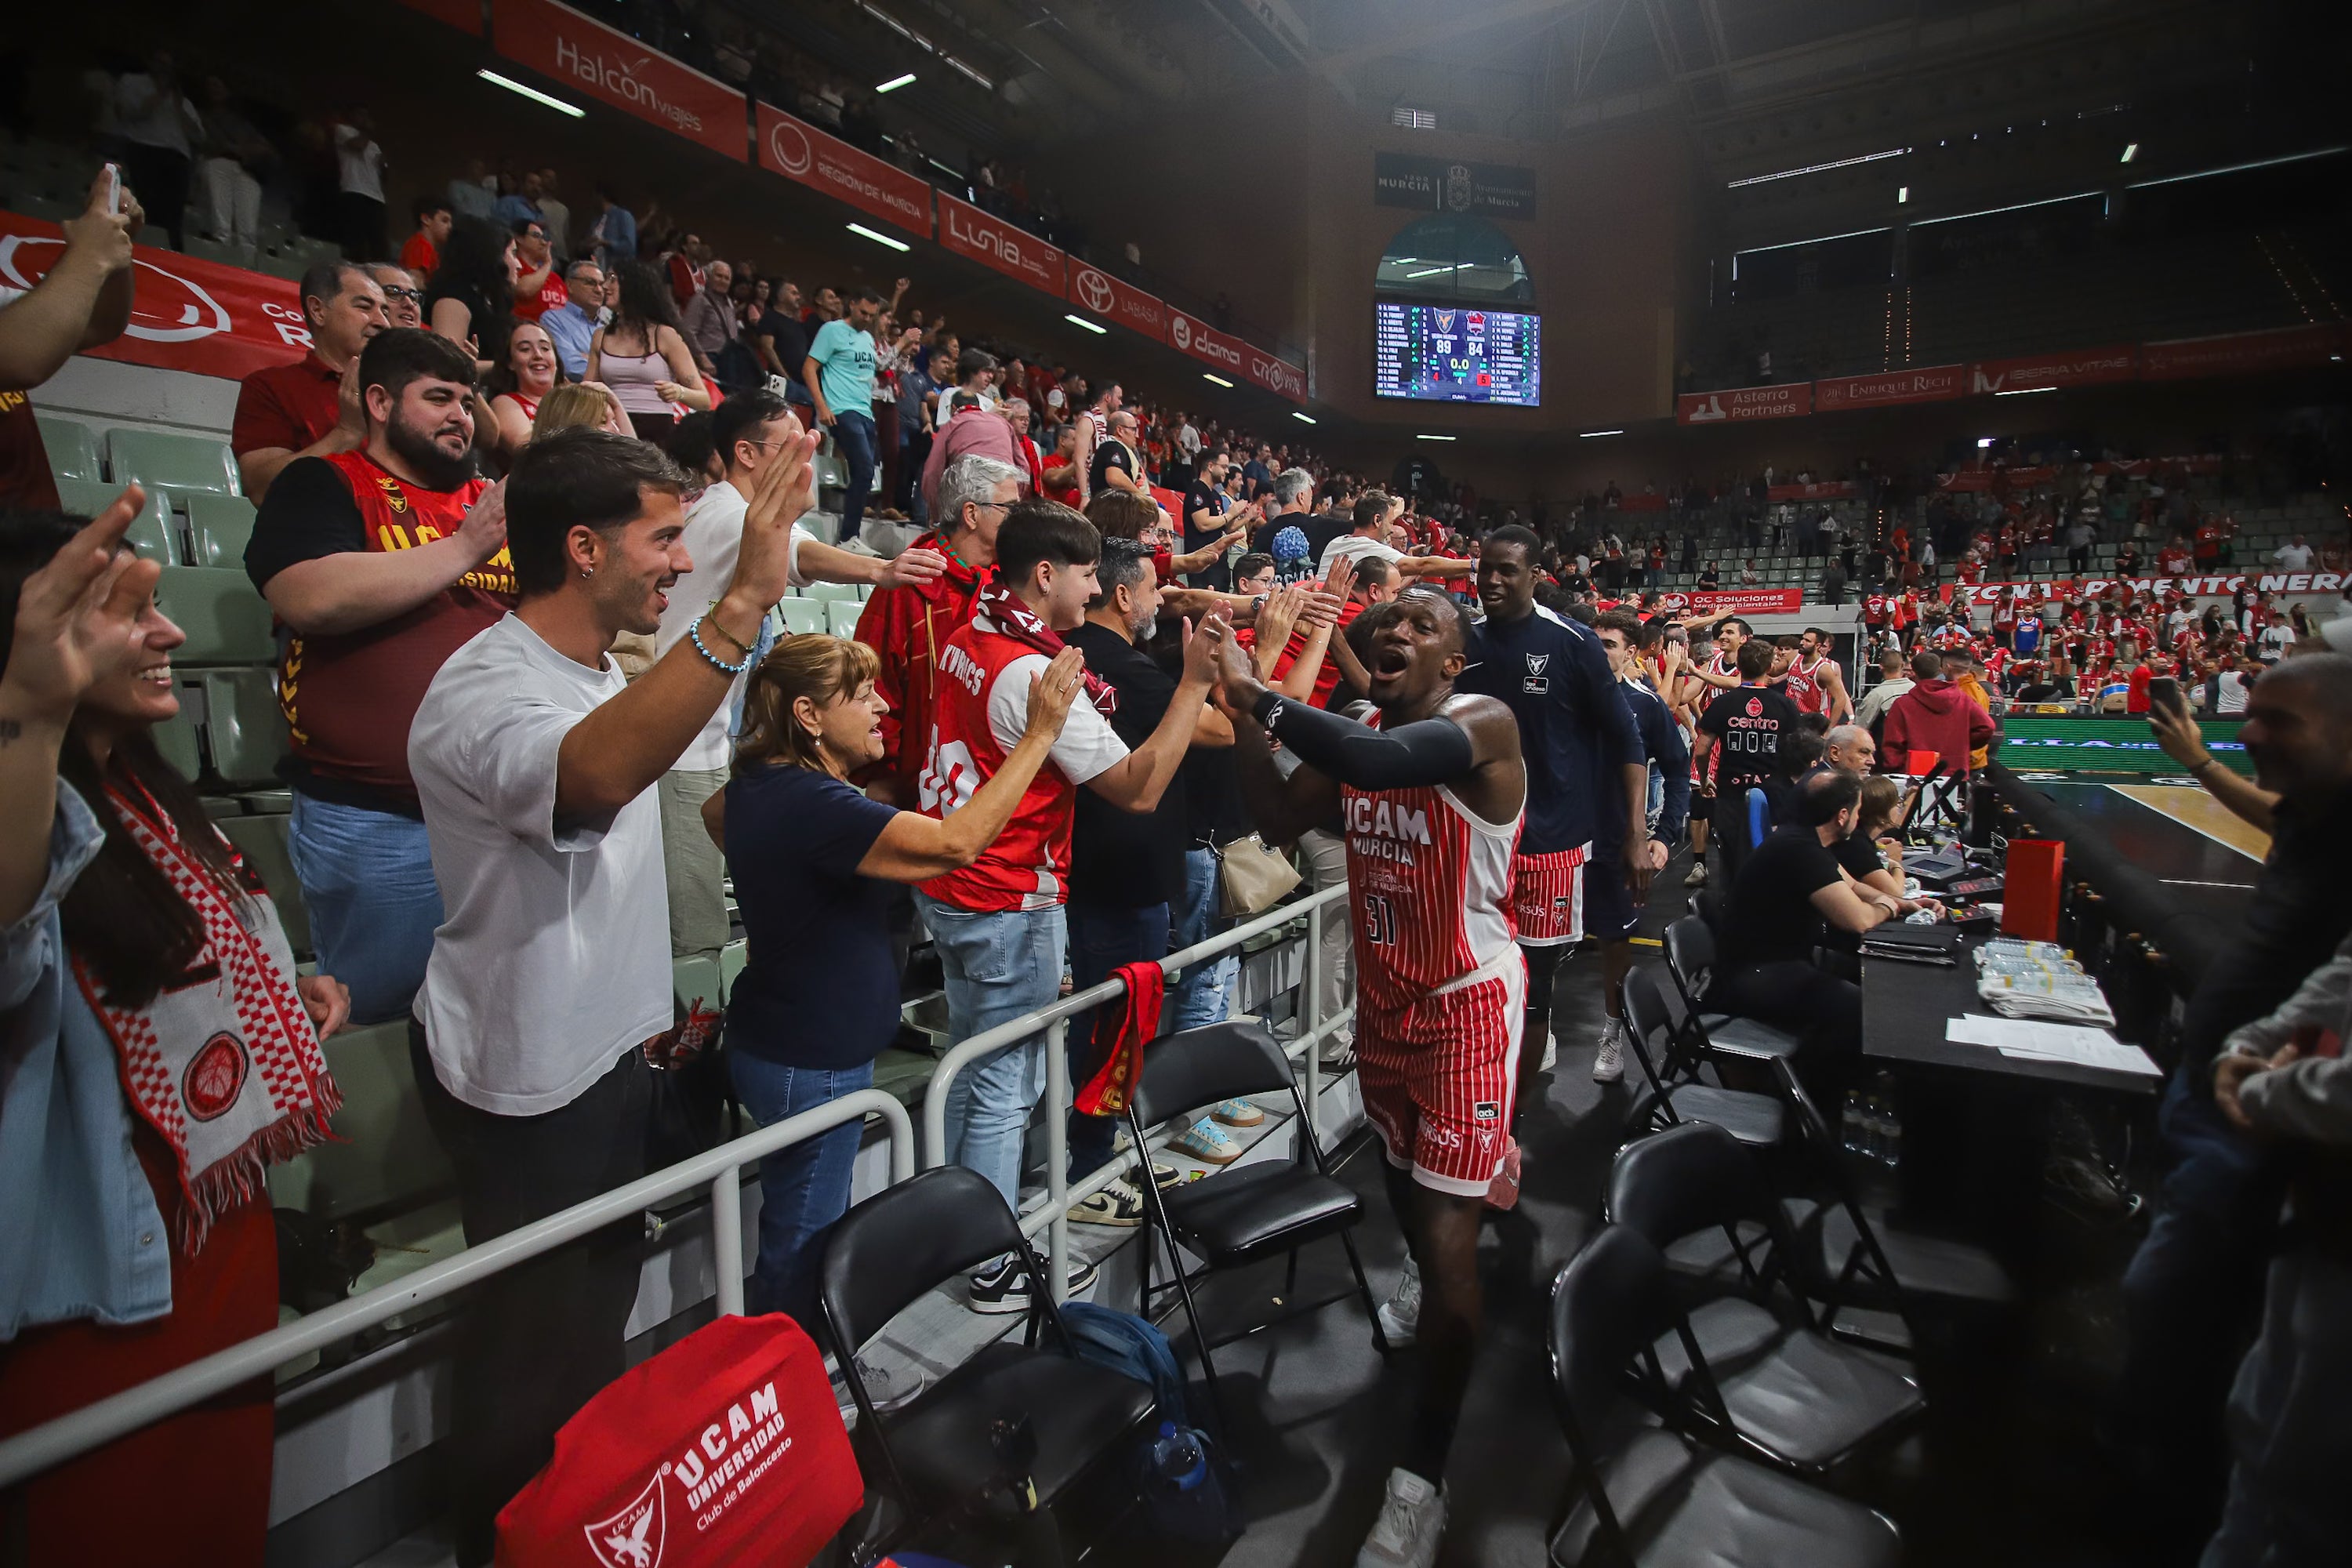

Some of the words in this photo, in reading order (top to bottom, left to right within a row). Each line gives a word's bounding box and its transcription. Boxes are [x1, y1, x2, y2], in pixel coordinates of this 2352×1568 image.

[657, 98, 703, 132] viajes
[1378, 176, 1430, 192] MURCIA
[864, 183, 880, 200] DE
[882, 191, 922, 219] MURCIA
[1489, 197, 1519, 207] Murcia
[1436, 339, 1452, 354] 89
[1468, 342, 1484, 357] 84
[1450, 358, 1470, 369] 0.0
[1432, 372, 1439, 382] 4
[1481, 376, 1486, 384] 5
[2010, 365, 2070, 380] IBERIA
[1849, 380, 1907, 398] ENRIQUE
[1733, 390, 1788, 404] Asterra
[1733, 403, 1796, 418] Partners
[1716, 593, 1784, 603] Soluciones
[1727, 716, 1779, 731] centro
[1352, 837, 1414, 867] MURCIA
[1380, 881, 1413, 894] MURCIA
[1365, 893, 1396, 946] 31
[1478, 1108, 1496, 1118] acb
[673, 1381, 779, 1490] UCAM
[687, 1412, 786, 1512] UNIVERSIDAD
[697, 1504, 723, 1531] Club
[723, 1490, 738, 1508] de
[736, 1436, 792, 1495] Baloncesto
[612, 1504, 647, 1536] UCAM
